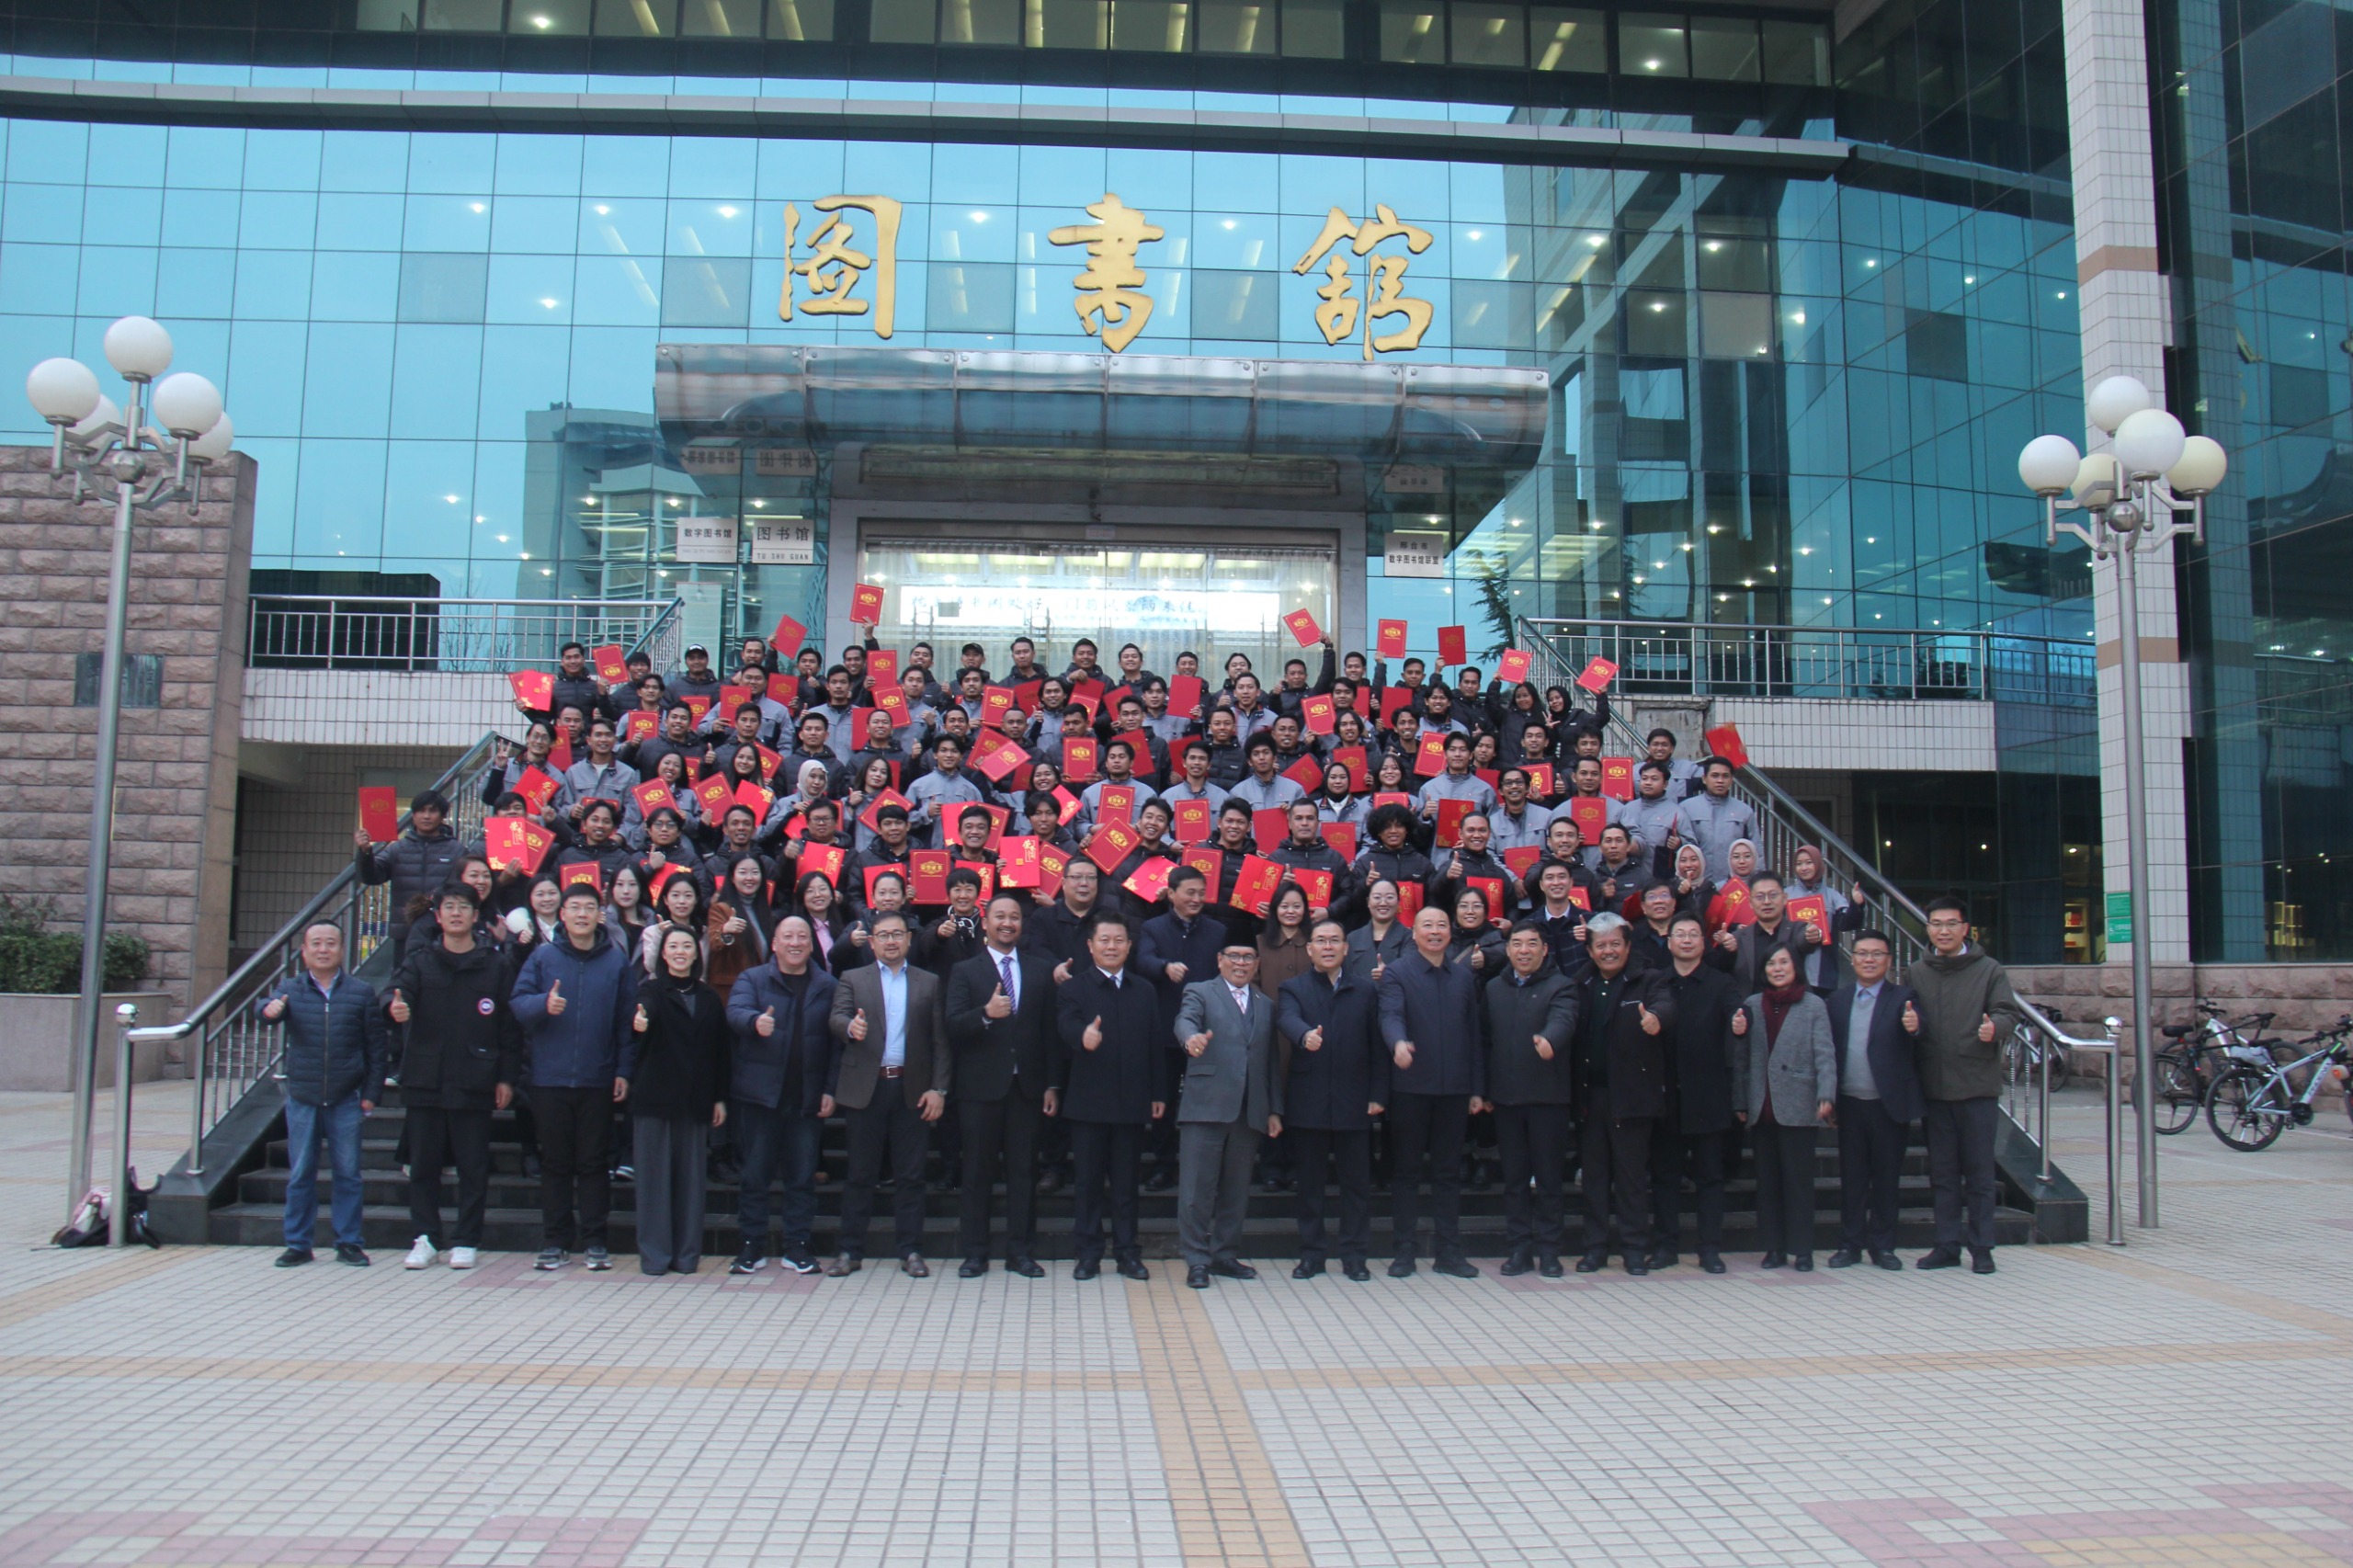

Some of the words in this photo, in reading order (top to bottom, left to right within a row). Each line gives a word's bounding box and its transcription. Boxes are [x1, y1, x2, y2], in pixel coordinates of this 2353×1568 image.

[684, 528, 733, 538] 数字图书馆
[756, 526, 810, 541] 图书馆
